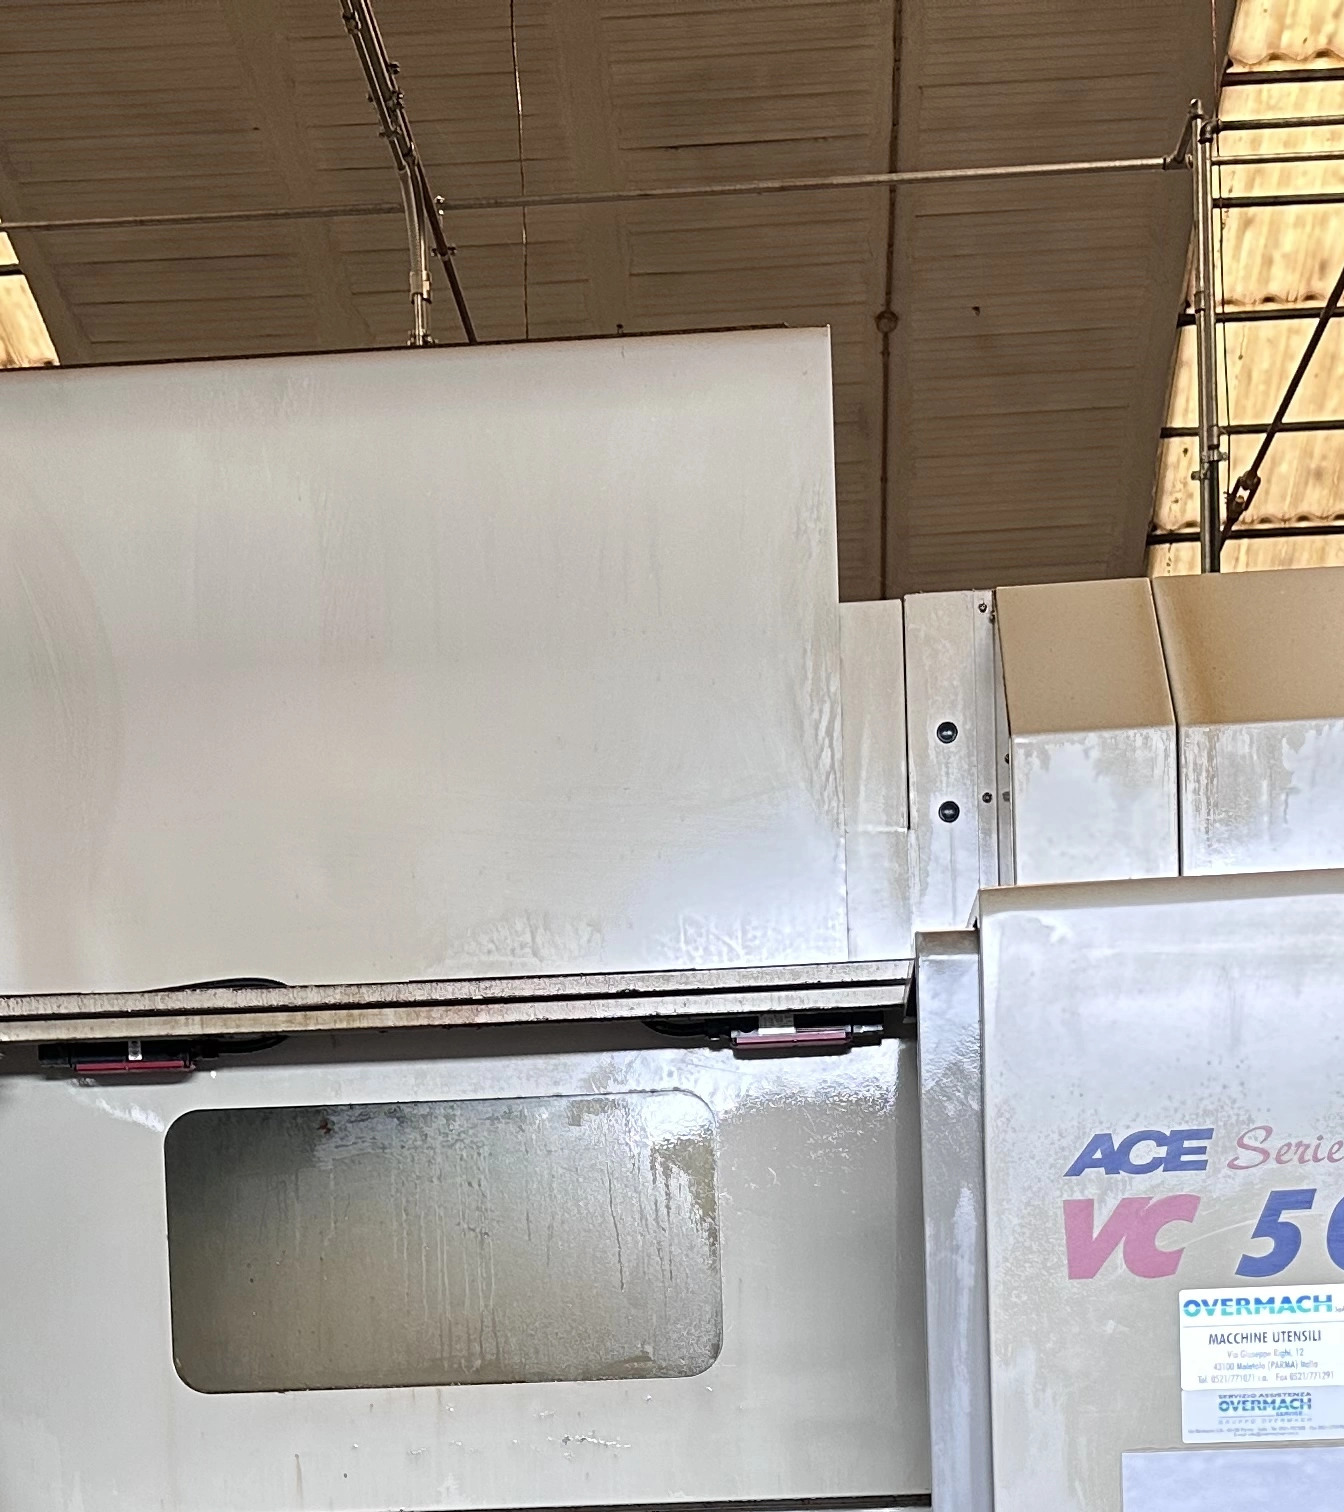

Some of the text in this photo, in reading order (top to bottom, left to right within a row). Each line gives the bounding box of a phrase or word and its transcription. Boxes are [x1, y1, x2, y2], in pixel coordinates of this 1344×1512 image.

[1064, 1127, 1214, 1177] ACE
[1062, 1194, 1201, 1280] VC
[1183, 1294, 1333, 1317] OVERMACH
[1208, 1329, 1322, 1345] MACCHINE UTENSILI
[1295, 1348, 1304, 1357] 12
[1218, 1398, 1312, 1412] OVERMACH
